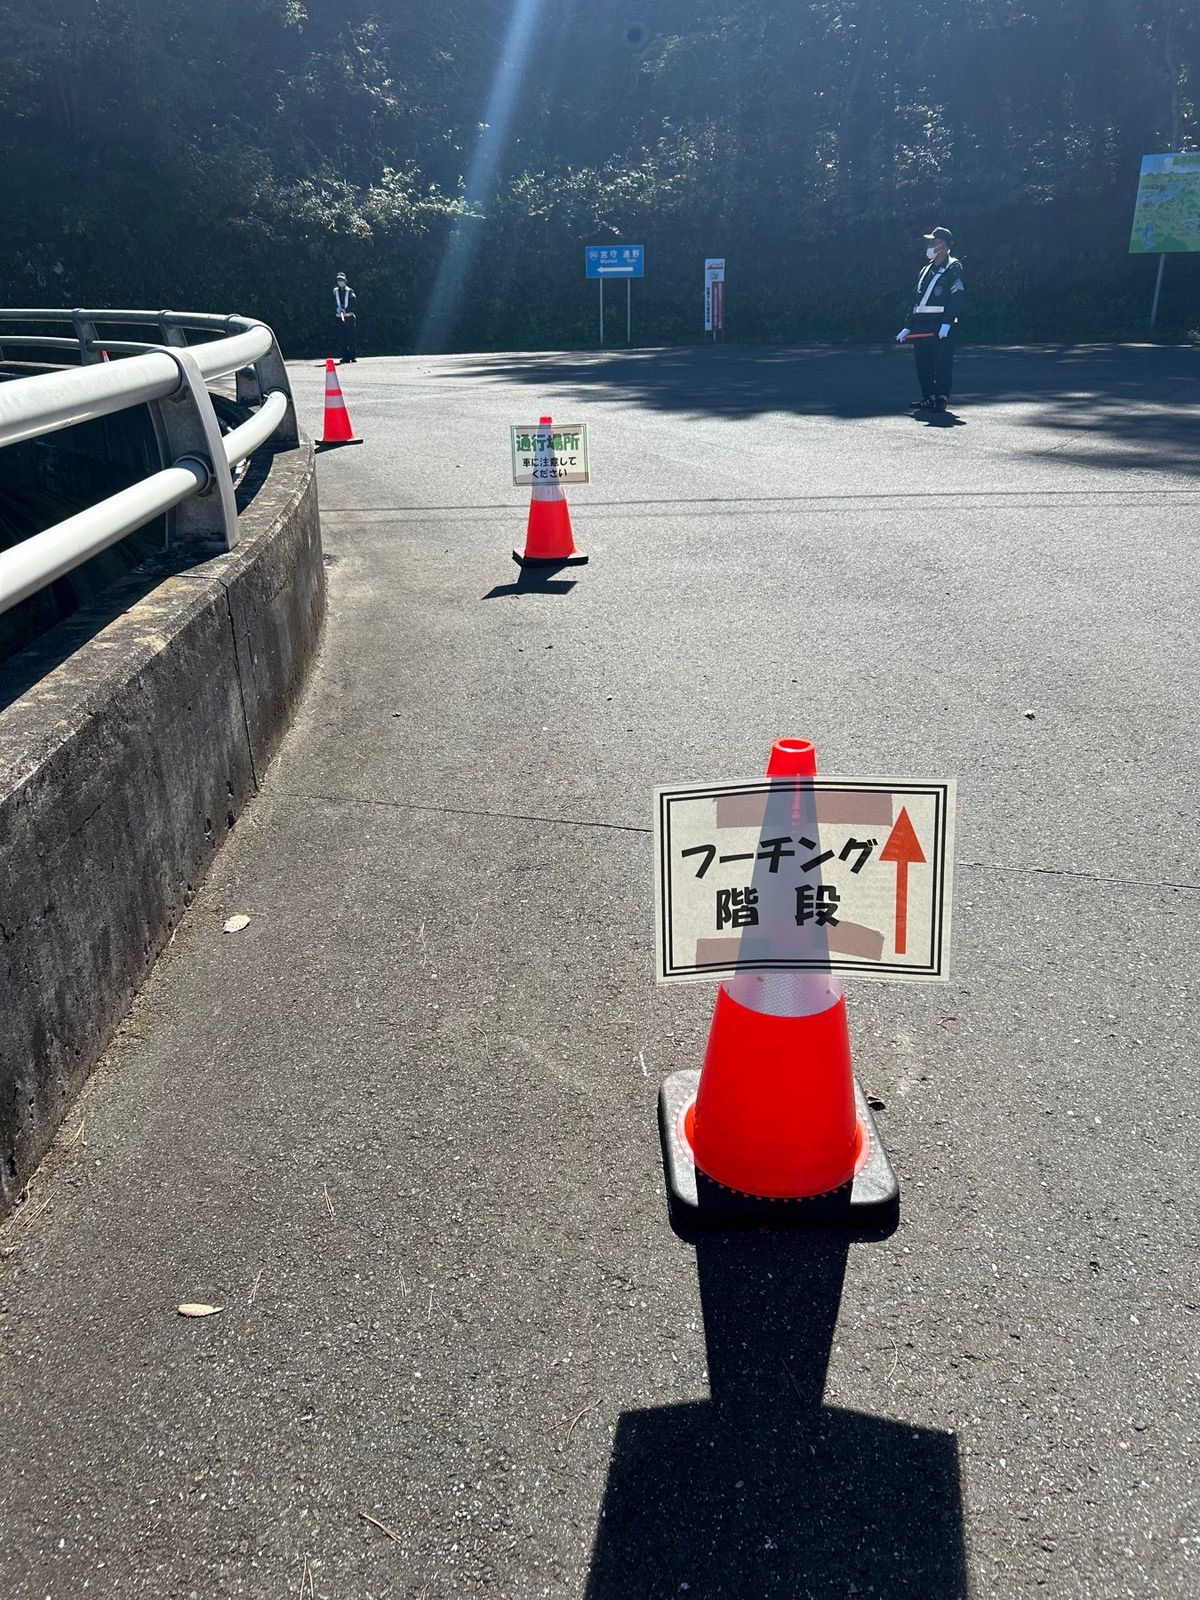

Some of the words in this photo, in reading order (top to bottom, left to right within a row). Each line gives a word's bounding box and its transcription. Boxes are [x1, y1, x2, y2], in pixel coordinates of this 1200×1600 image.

[516, 433, 580, 452] 通行場所
[522, 456, 577, 468] 車に注意して
[532, 468, 568, 479] ください
[681, 836, 878, 879] フーチング
